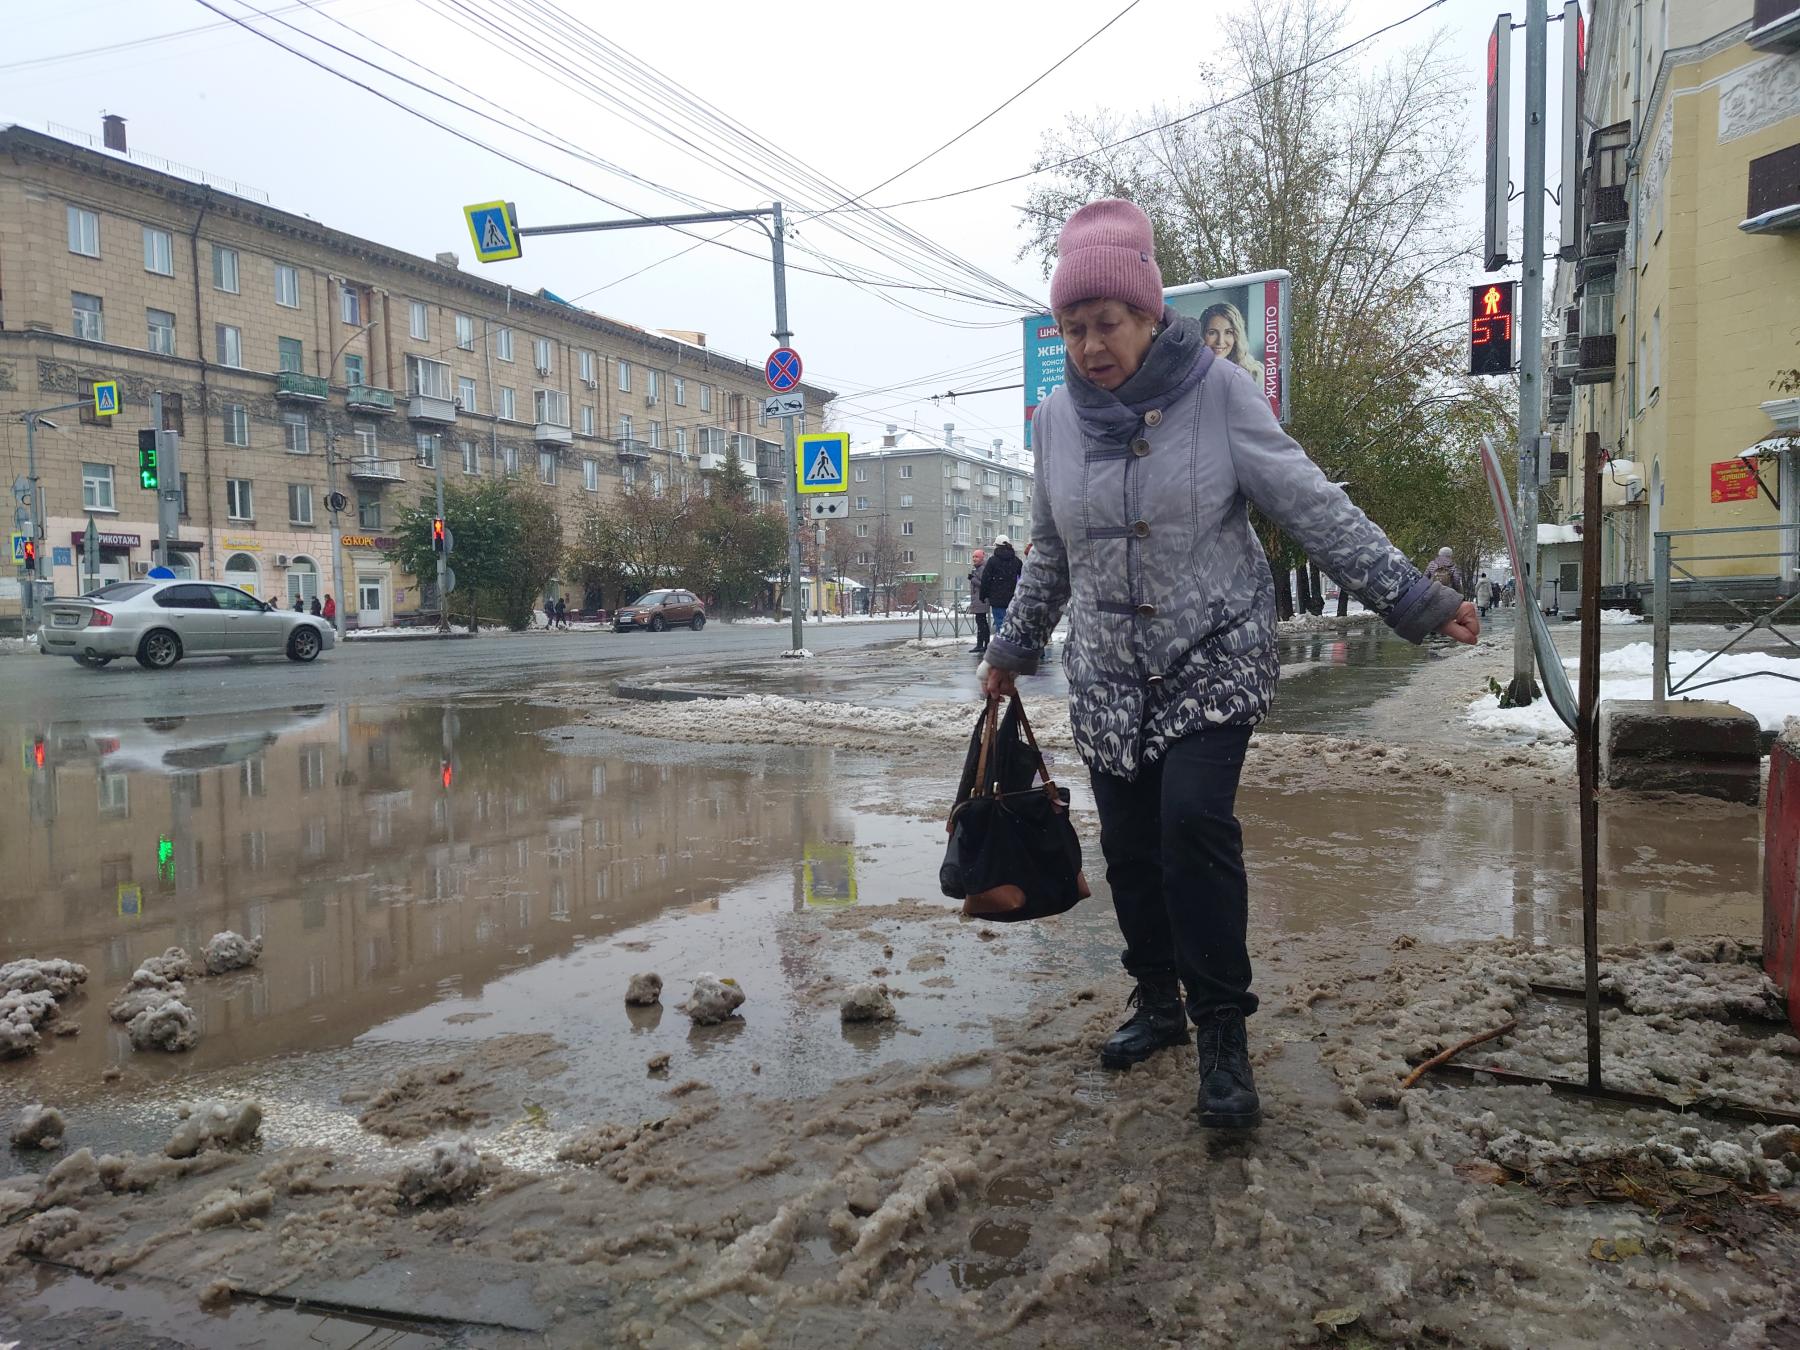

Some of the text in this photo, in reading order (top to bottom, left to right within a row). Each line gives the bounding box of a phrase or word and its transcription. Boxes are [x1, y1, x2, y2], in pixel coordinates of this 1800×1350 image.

[1266, 306, 1277, 399] ЖИВИ ДОЛГО
[1473, 314, 1510, 344] 57
